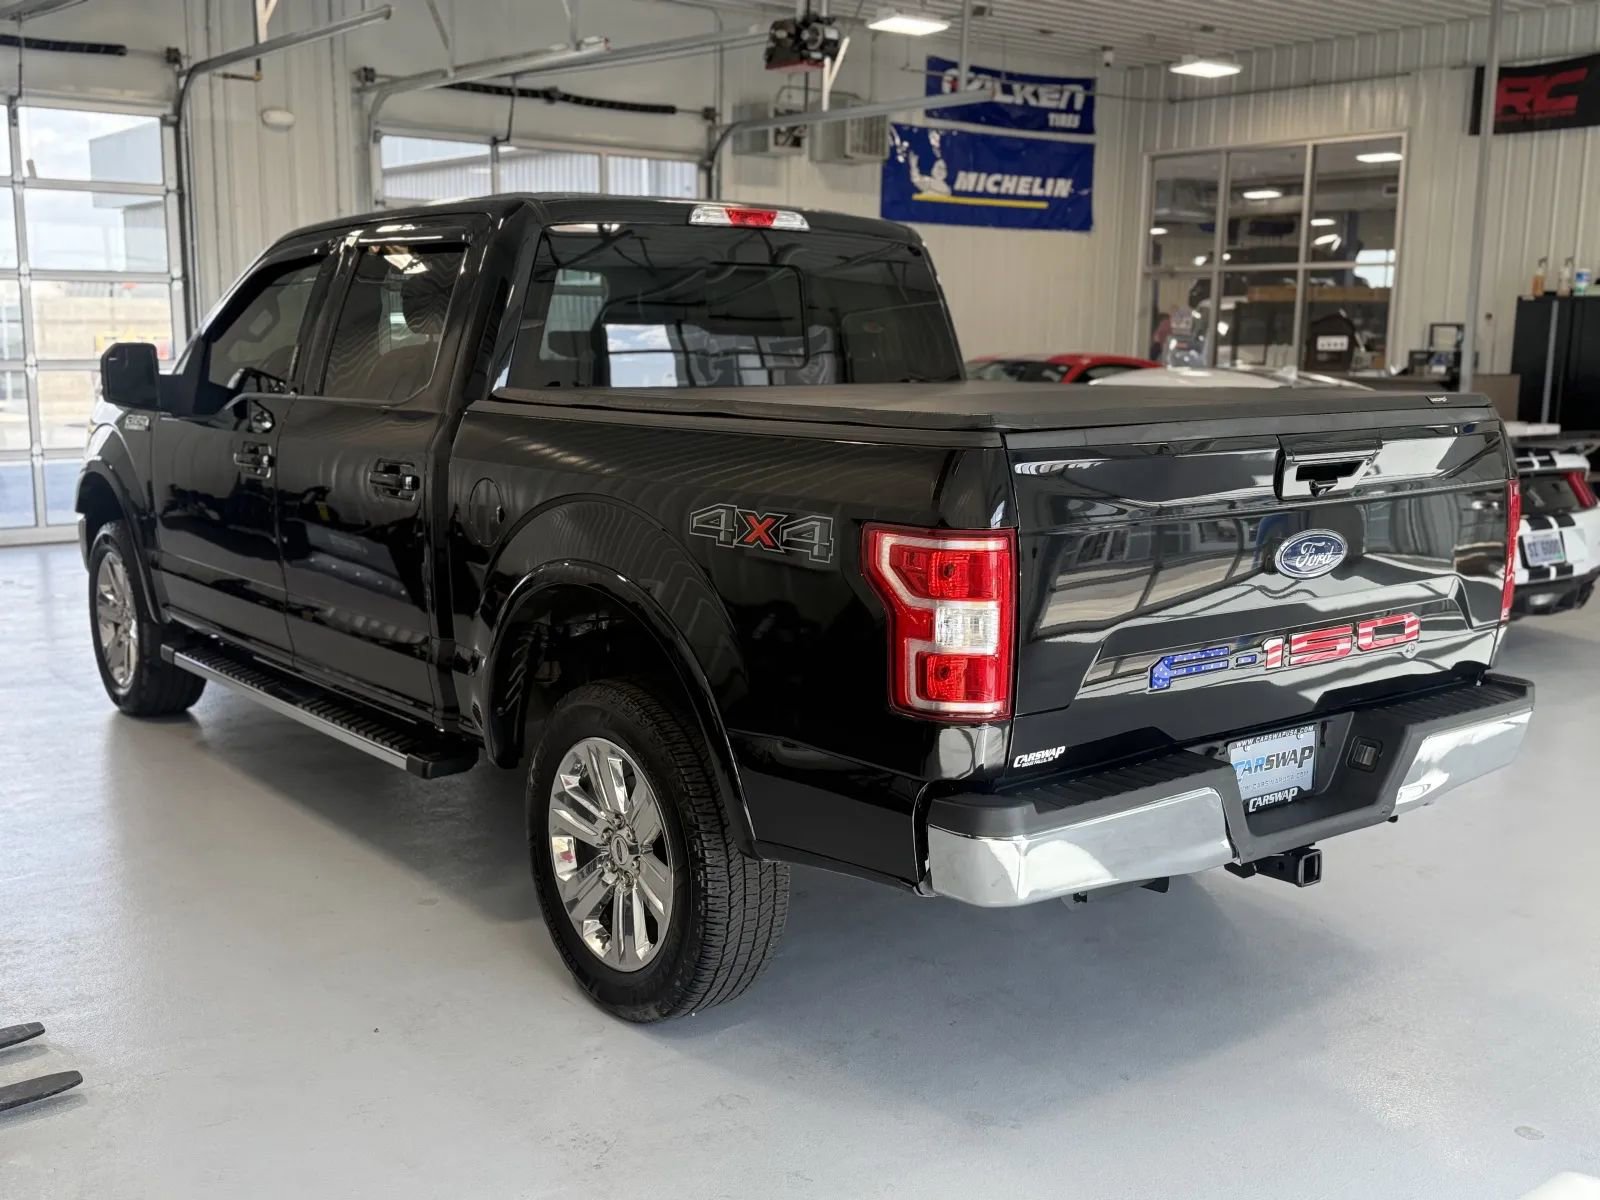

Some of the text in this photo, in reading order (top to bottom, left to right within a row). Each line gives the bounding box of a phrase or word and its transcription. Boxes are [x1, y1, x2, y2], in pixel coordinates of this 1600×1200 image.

[953, 171, 1073, 198] MICHELIN
[1295, 541, 1335, 568] Ford
[1148, 612, 1420, 693] F-150
[1013, 746, 1066, 768] CARSWAP
[1233, 745, 1314, 782] CARSWAP
[1249, 787, 1299, 813] CARSWAP
